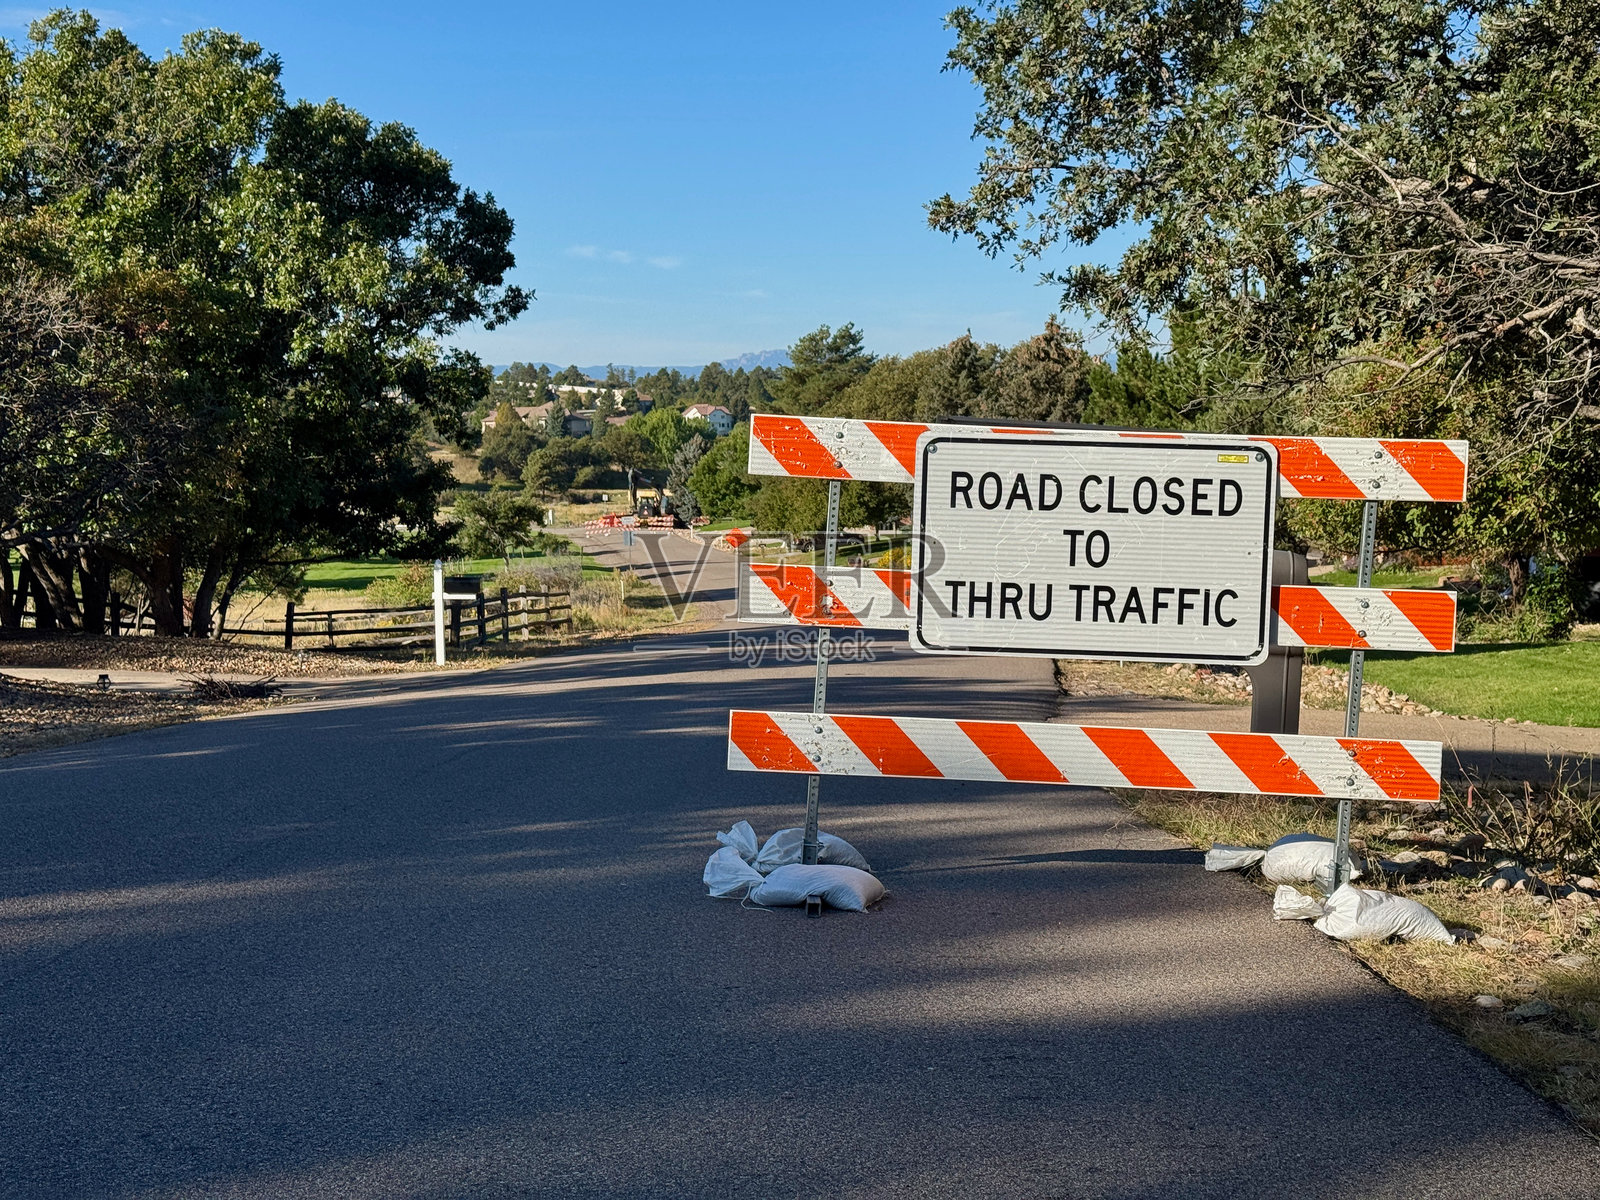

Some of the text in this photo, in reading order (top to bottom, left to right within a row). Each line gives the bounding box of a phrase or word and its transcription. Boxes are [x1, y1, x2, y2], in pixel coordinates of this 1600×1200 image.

[950, 471, 1243, 517] ROAD CLOSED
[1062, 529, 1110, 569] TO
[944, 580, 1239, 628] THRU TRAFFIC
